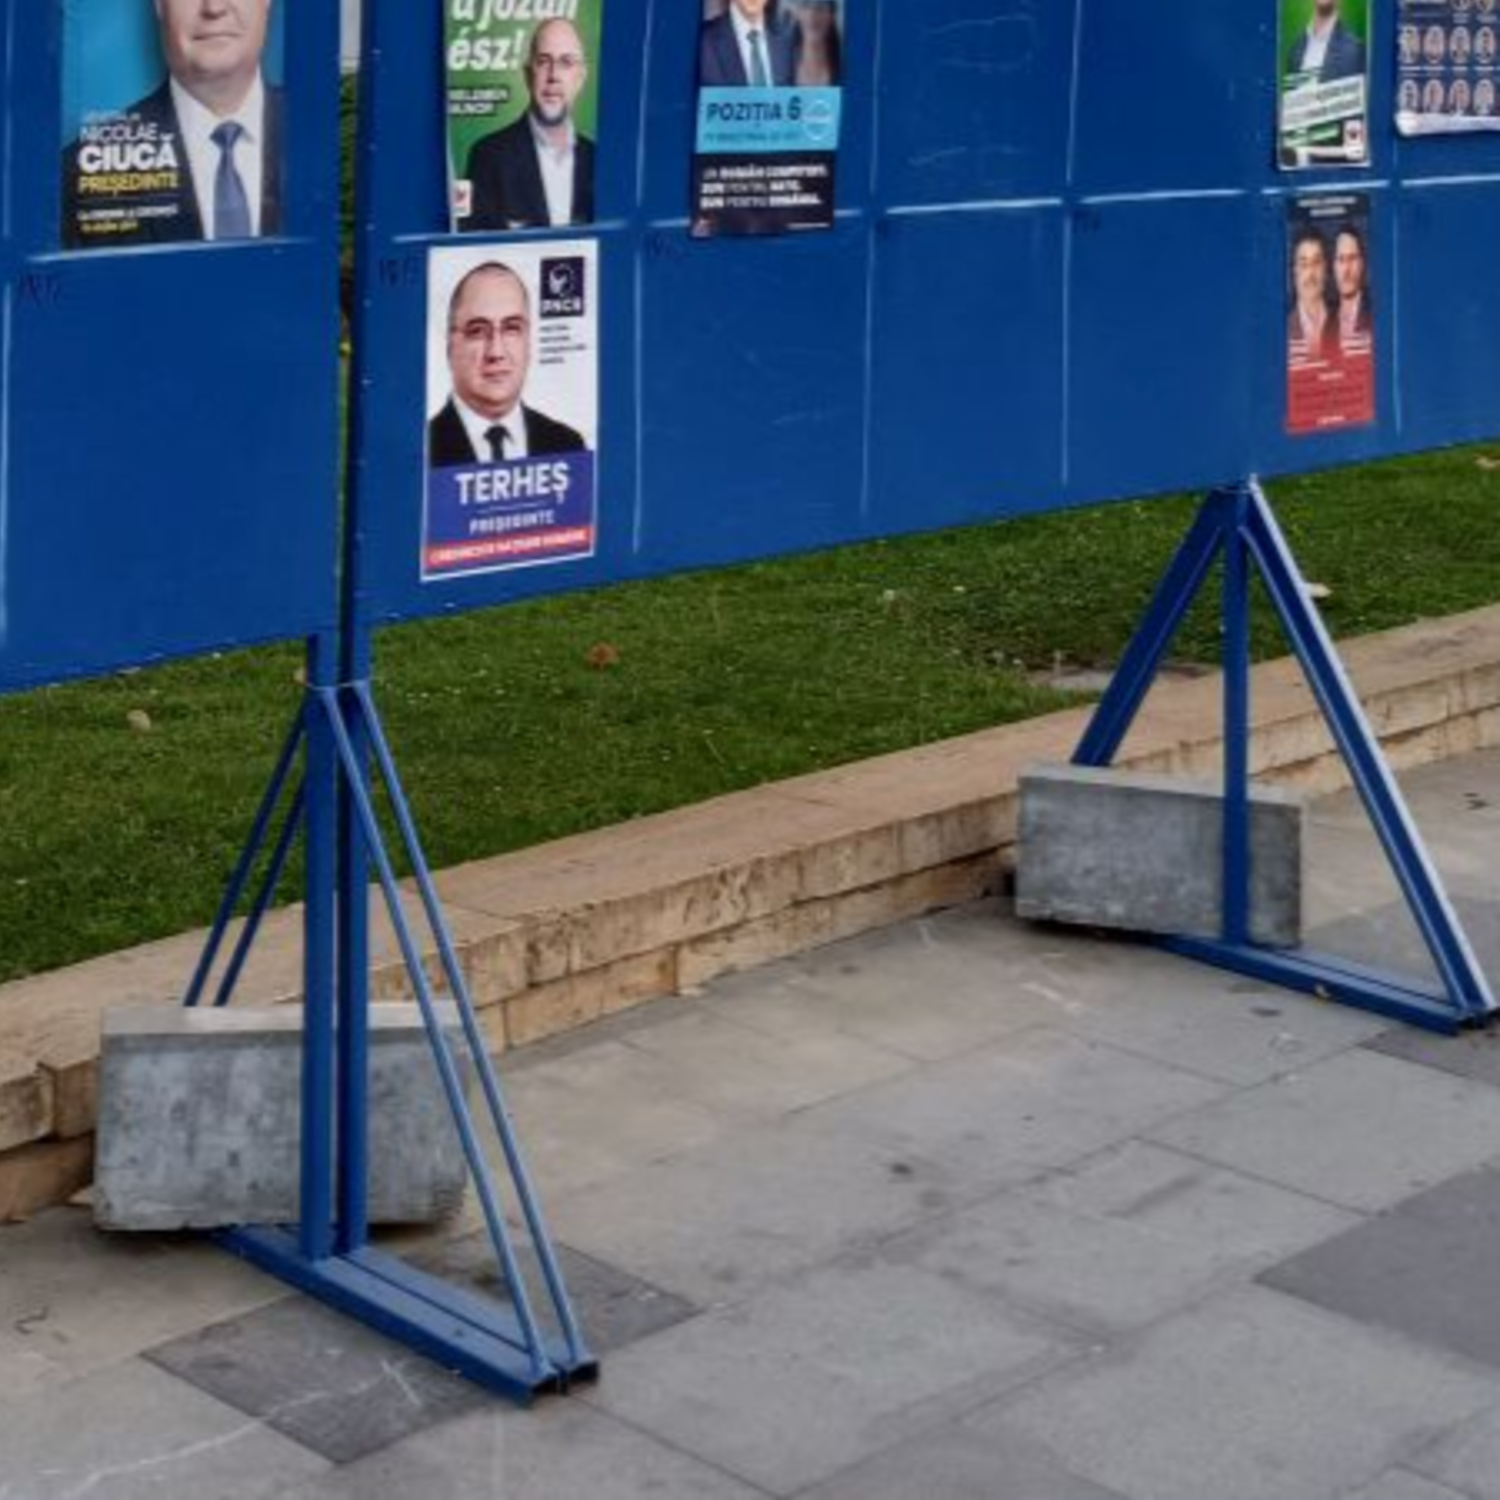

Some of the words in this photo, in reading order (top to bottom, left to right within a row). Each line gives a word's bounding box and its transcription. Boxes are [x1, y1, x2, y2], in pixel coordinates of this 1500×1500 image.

[449, 27, 525, 70] ész!
[78, 133, 179, 174] CIUCĂ
[454, 462, 571, 505] TERHEȘ
